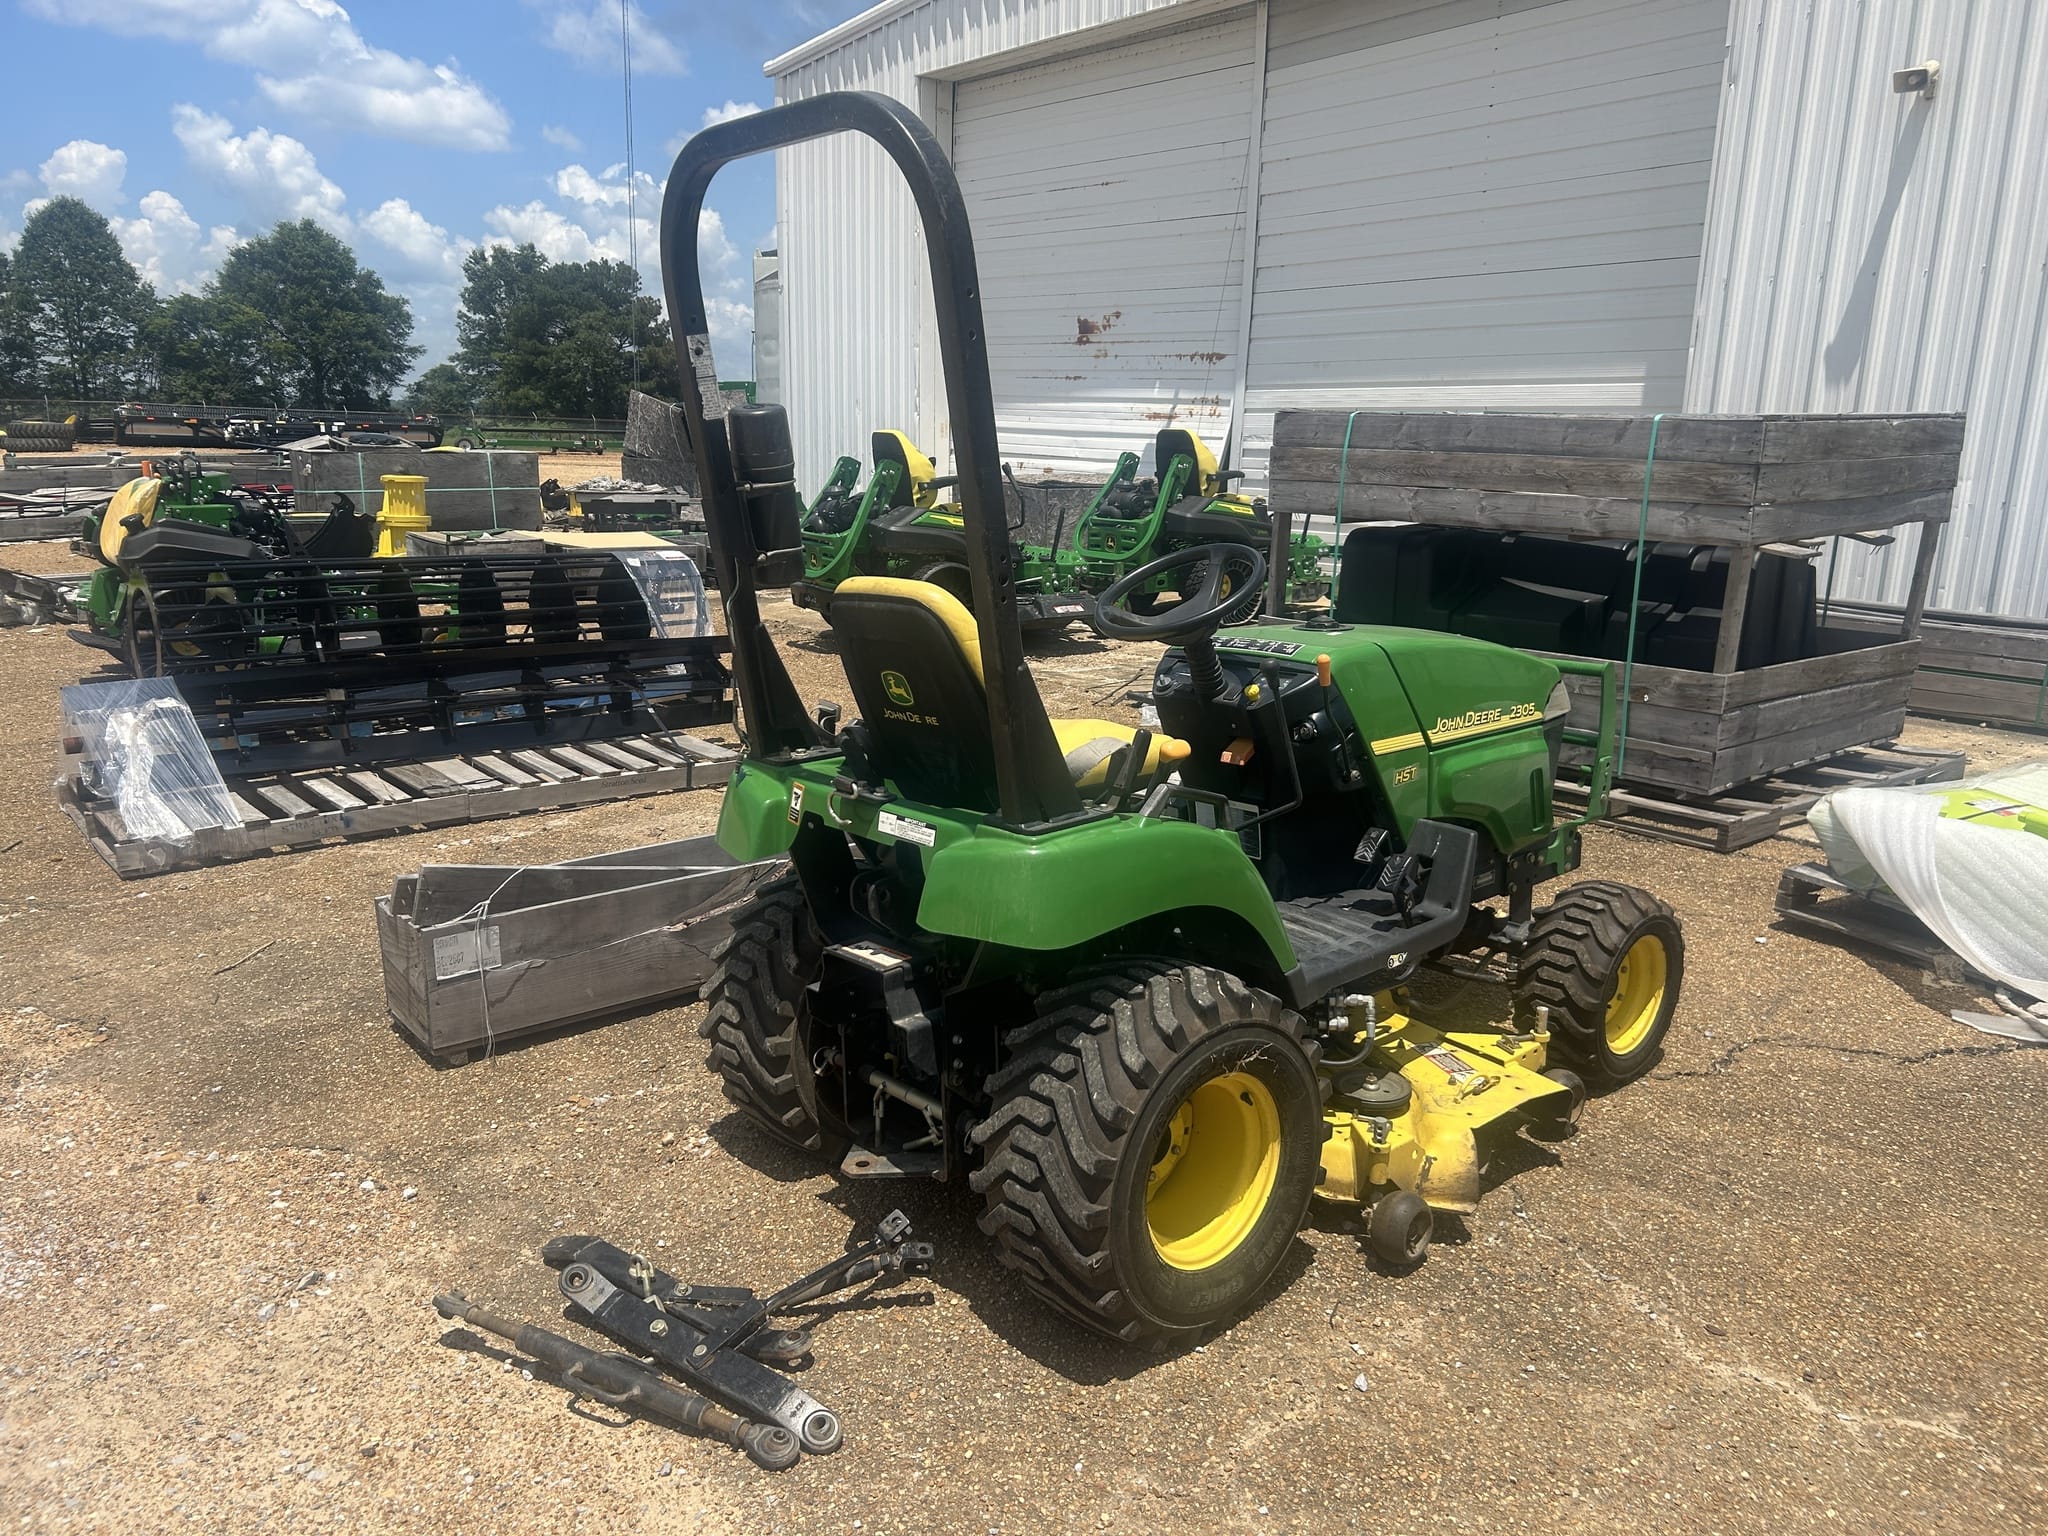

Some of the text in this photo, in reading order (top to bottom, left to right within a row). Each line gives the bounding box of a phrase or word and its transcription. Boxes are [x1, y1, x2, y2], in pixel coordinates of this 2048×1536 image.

[884, 708, 907, 720] JOHN
[1432, 702, 1535, 734] JOHN DEERE 2305
[1395, 767, 1417, 785] HST
